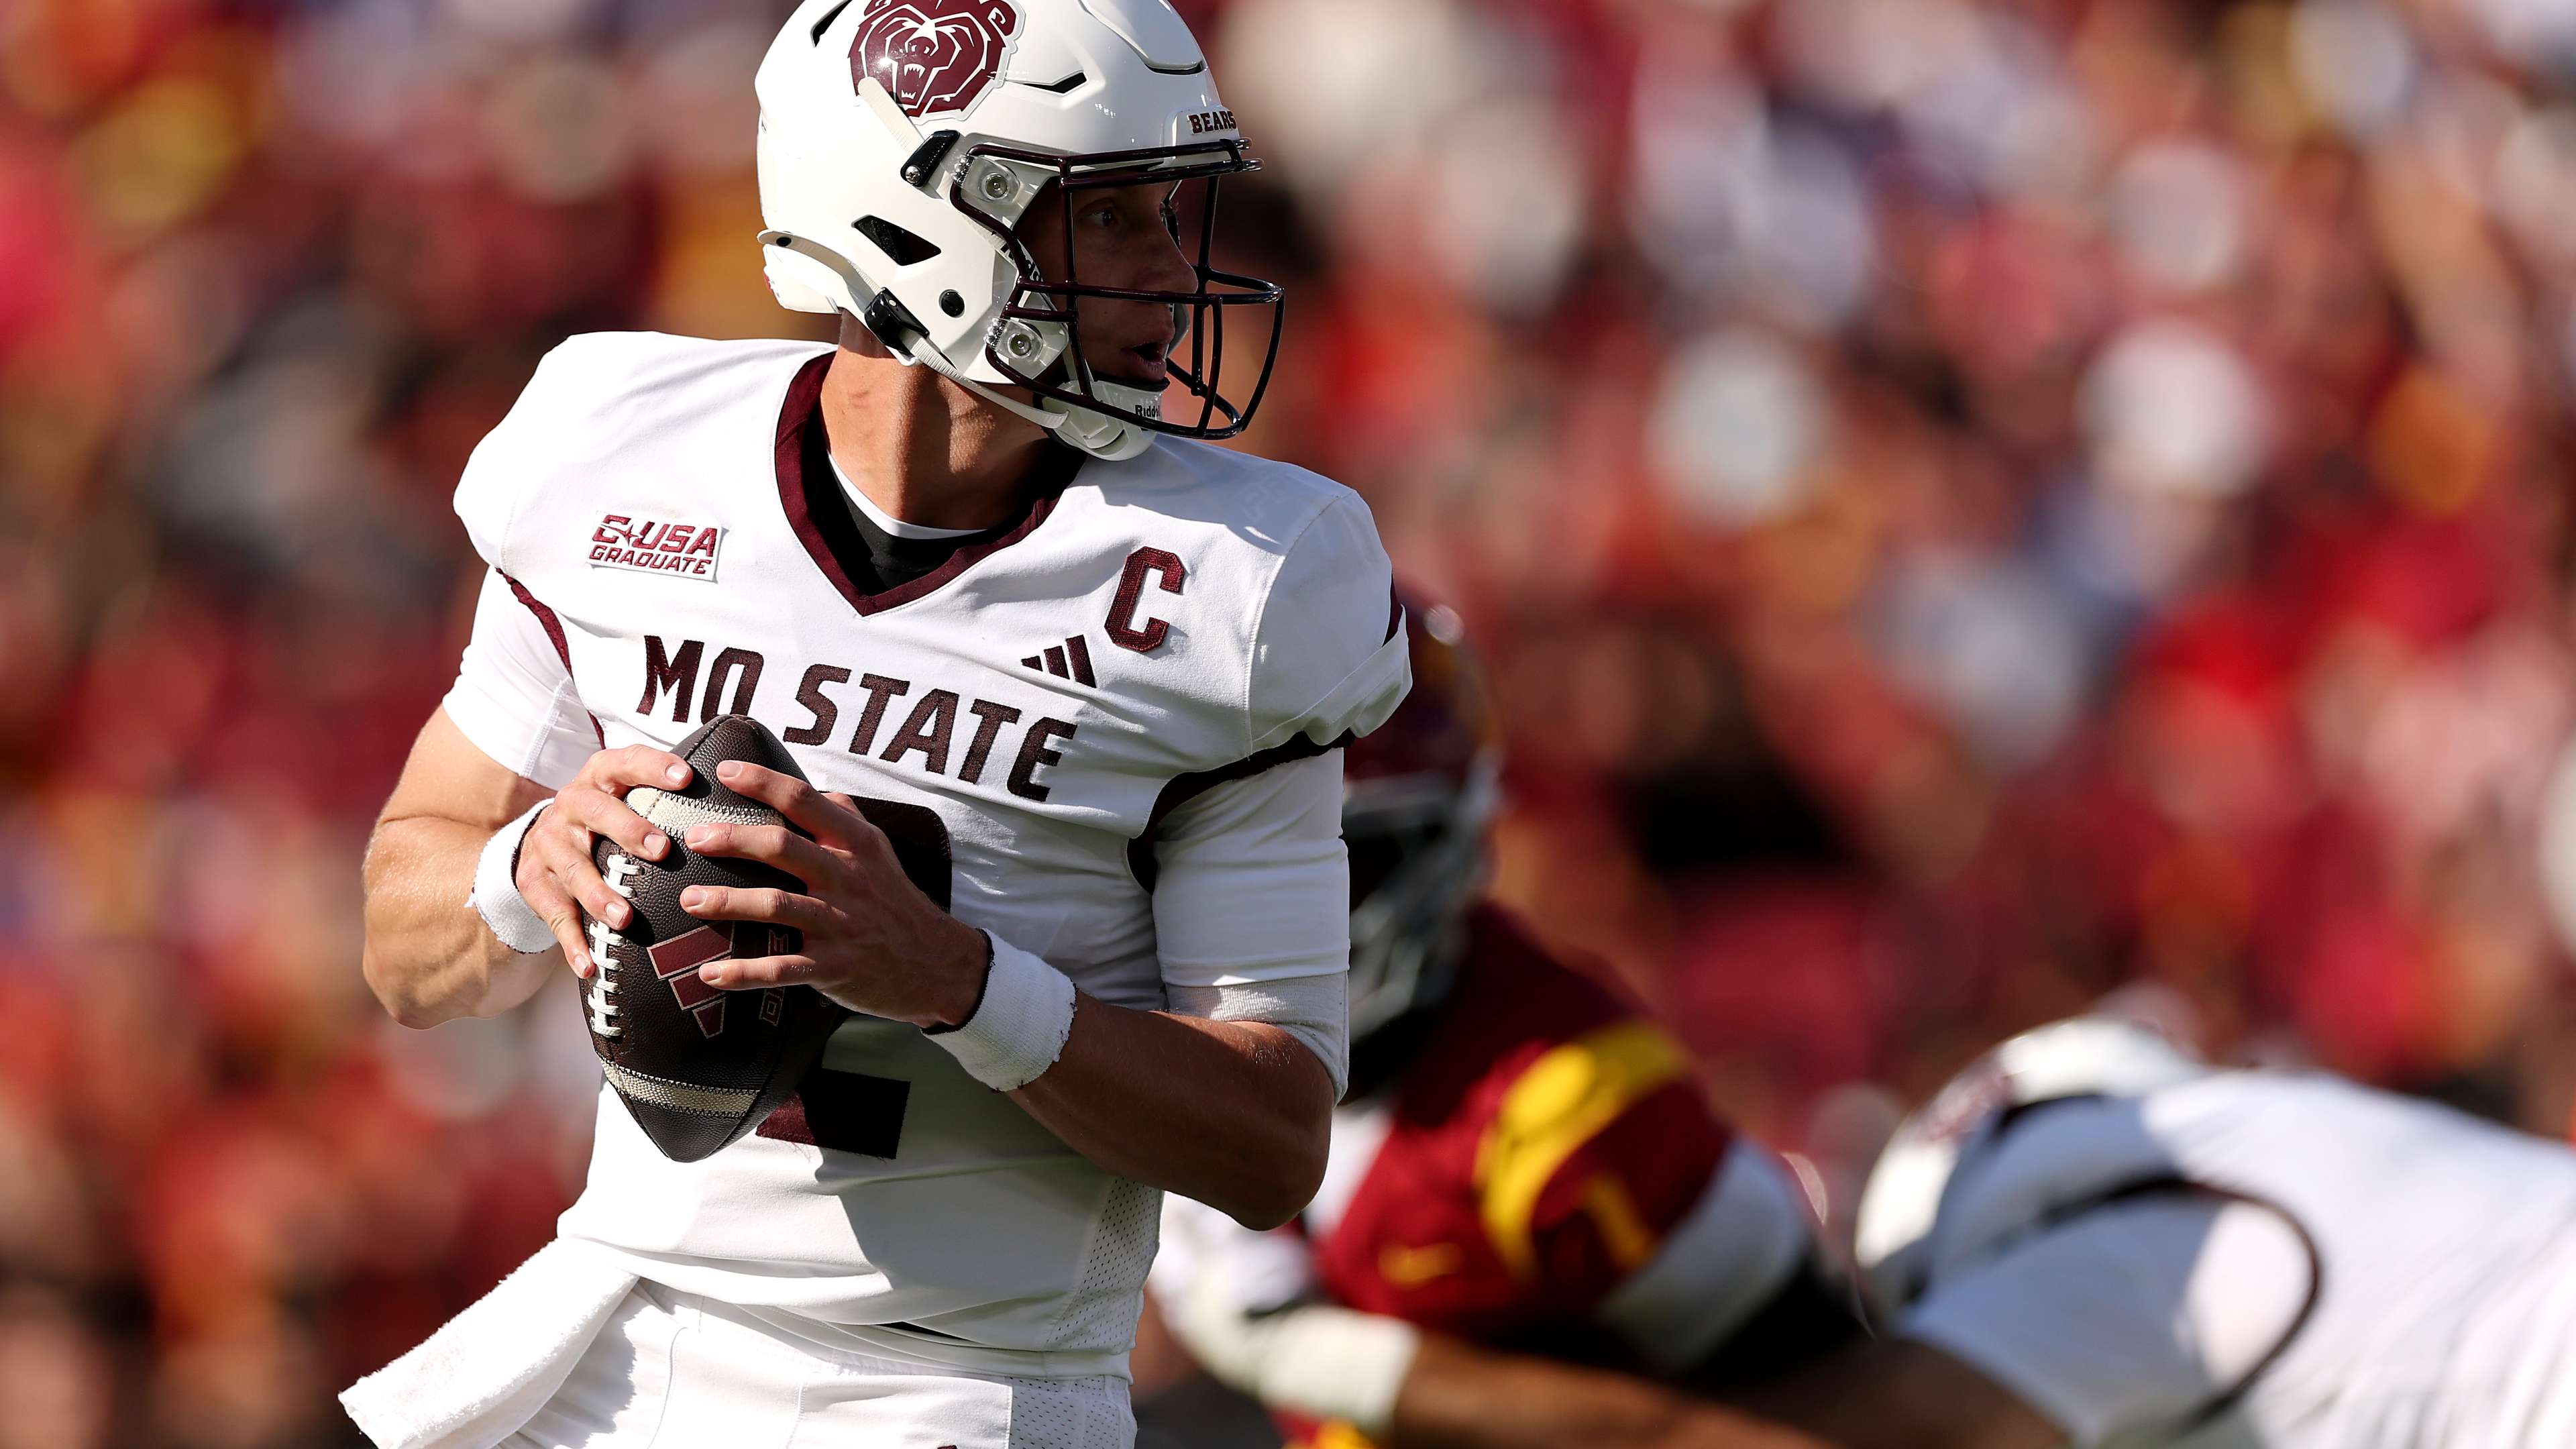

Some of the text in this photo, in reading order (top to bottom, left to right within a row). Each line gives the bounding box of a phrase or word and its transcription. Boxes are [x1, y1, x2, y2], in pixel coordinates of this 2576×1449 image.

[1187, 111, 1237, 134] BEARS
[588, 544, 712, 574] GRADUATE
[1104, 545, 1185, 653] C
[635, 635, 1078, 803] MO STATE
